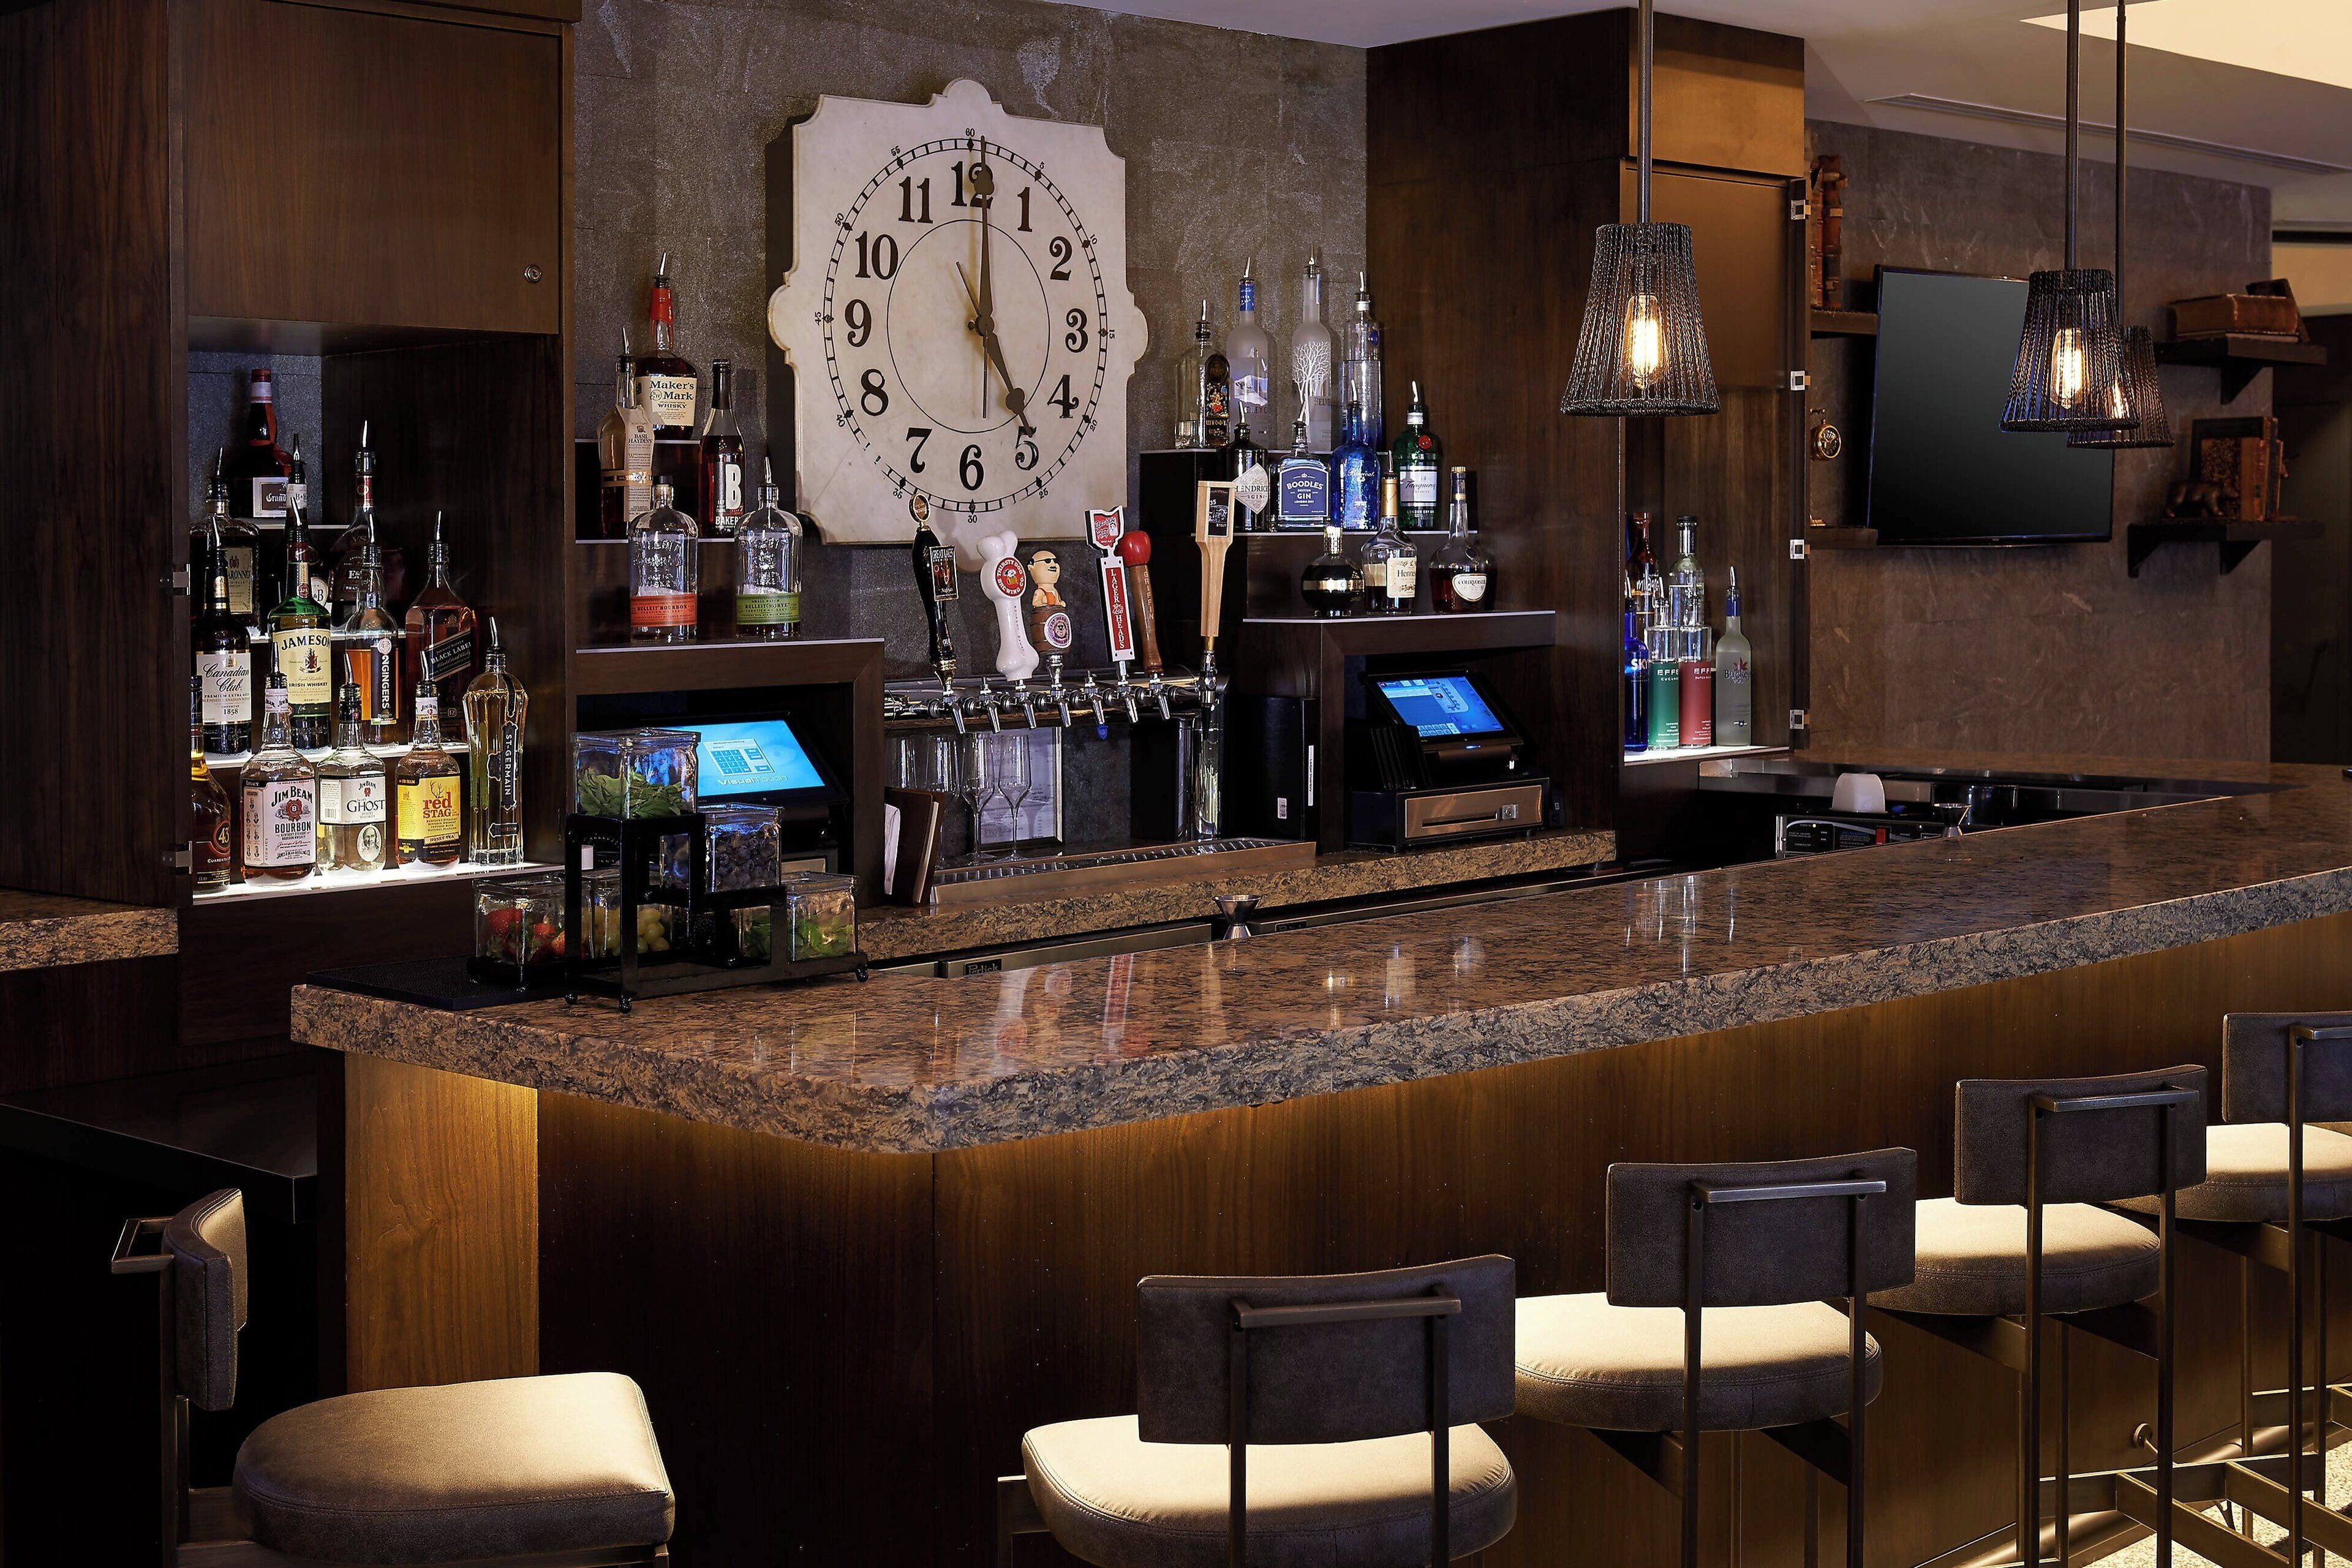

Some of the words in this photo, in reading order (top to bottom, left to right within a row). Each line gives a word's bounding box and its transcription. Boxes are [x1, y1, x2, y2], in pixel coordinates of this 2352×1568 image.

[965, 128, 976, 137] 60
[891, 146, 902, 157] 55
[1039, 160, 1046, 169] 5
[951, 161, 993, 209] 12
[898, 177, 934, 224] 11
[1017, 187, 1033, 232] 1
[834, 213, 845, 227] 50
[1090, 233, 1098, 246] 10
[855, 231, 899, 280] 10
[1049, 236, 1072, 281] 2
[815, 312, 822, 326] 45
[844, 298, 872, 347] 9
[1065, 308, 1088, 353] 3
[1109, 329, 1115, 339] 15
[650, 380, 694, 390] Maker's
[663, 391, 694, 400] Mark
[861, 369, 889, 417] 8
[1047, 374, 1079, 419] 4
[835, 415, 845, 428] 40
[1090, 419, 1099, 432] 20
[907, 427, 933, 474] 7
[1014, 425, 1038, 471] 5
[959, 444, 984, 491] 6
[726, 464, 741, 509] B
[1286, 481, 1324, 490] BOODLES
[266, 493, 287, 502] Grand
[893, 488, 904, 499] 35
[1039, 489, 1049, 499] 25
[967, 514, 978, 524] 30
[932, 549, 943, 559] GREAT
[349, 570, 362, 579] E&
[997, 560, 1014, 577] THIRSTY
[1014, 563, 1023, 575] DOG
[998, 578, 1020, 594] BREWING
[1144, 571, 1154, 620] GRIFFIN
[1110, 568, 1120, 603] LAGER
[1115, 614, 1125, 649] HEADS
[281, 635, 331, 650] JAMESON
[431, 650, 452, 664] BLACK
[203, 663, 250, 678] Canadian
[718, 775, 788, 786] VisualTouch
[271, 790, 289, 807] JIM
[290, 786, 313, 804] BEAM
[423, 791, 453, 810] red
[347, 799, 385, 813] GHOST
[423, 808, 452, 819] STAG
[275, 821, 311, 834] BOURBON
[219, 827, 230, 843] 43
